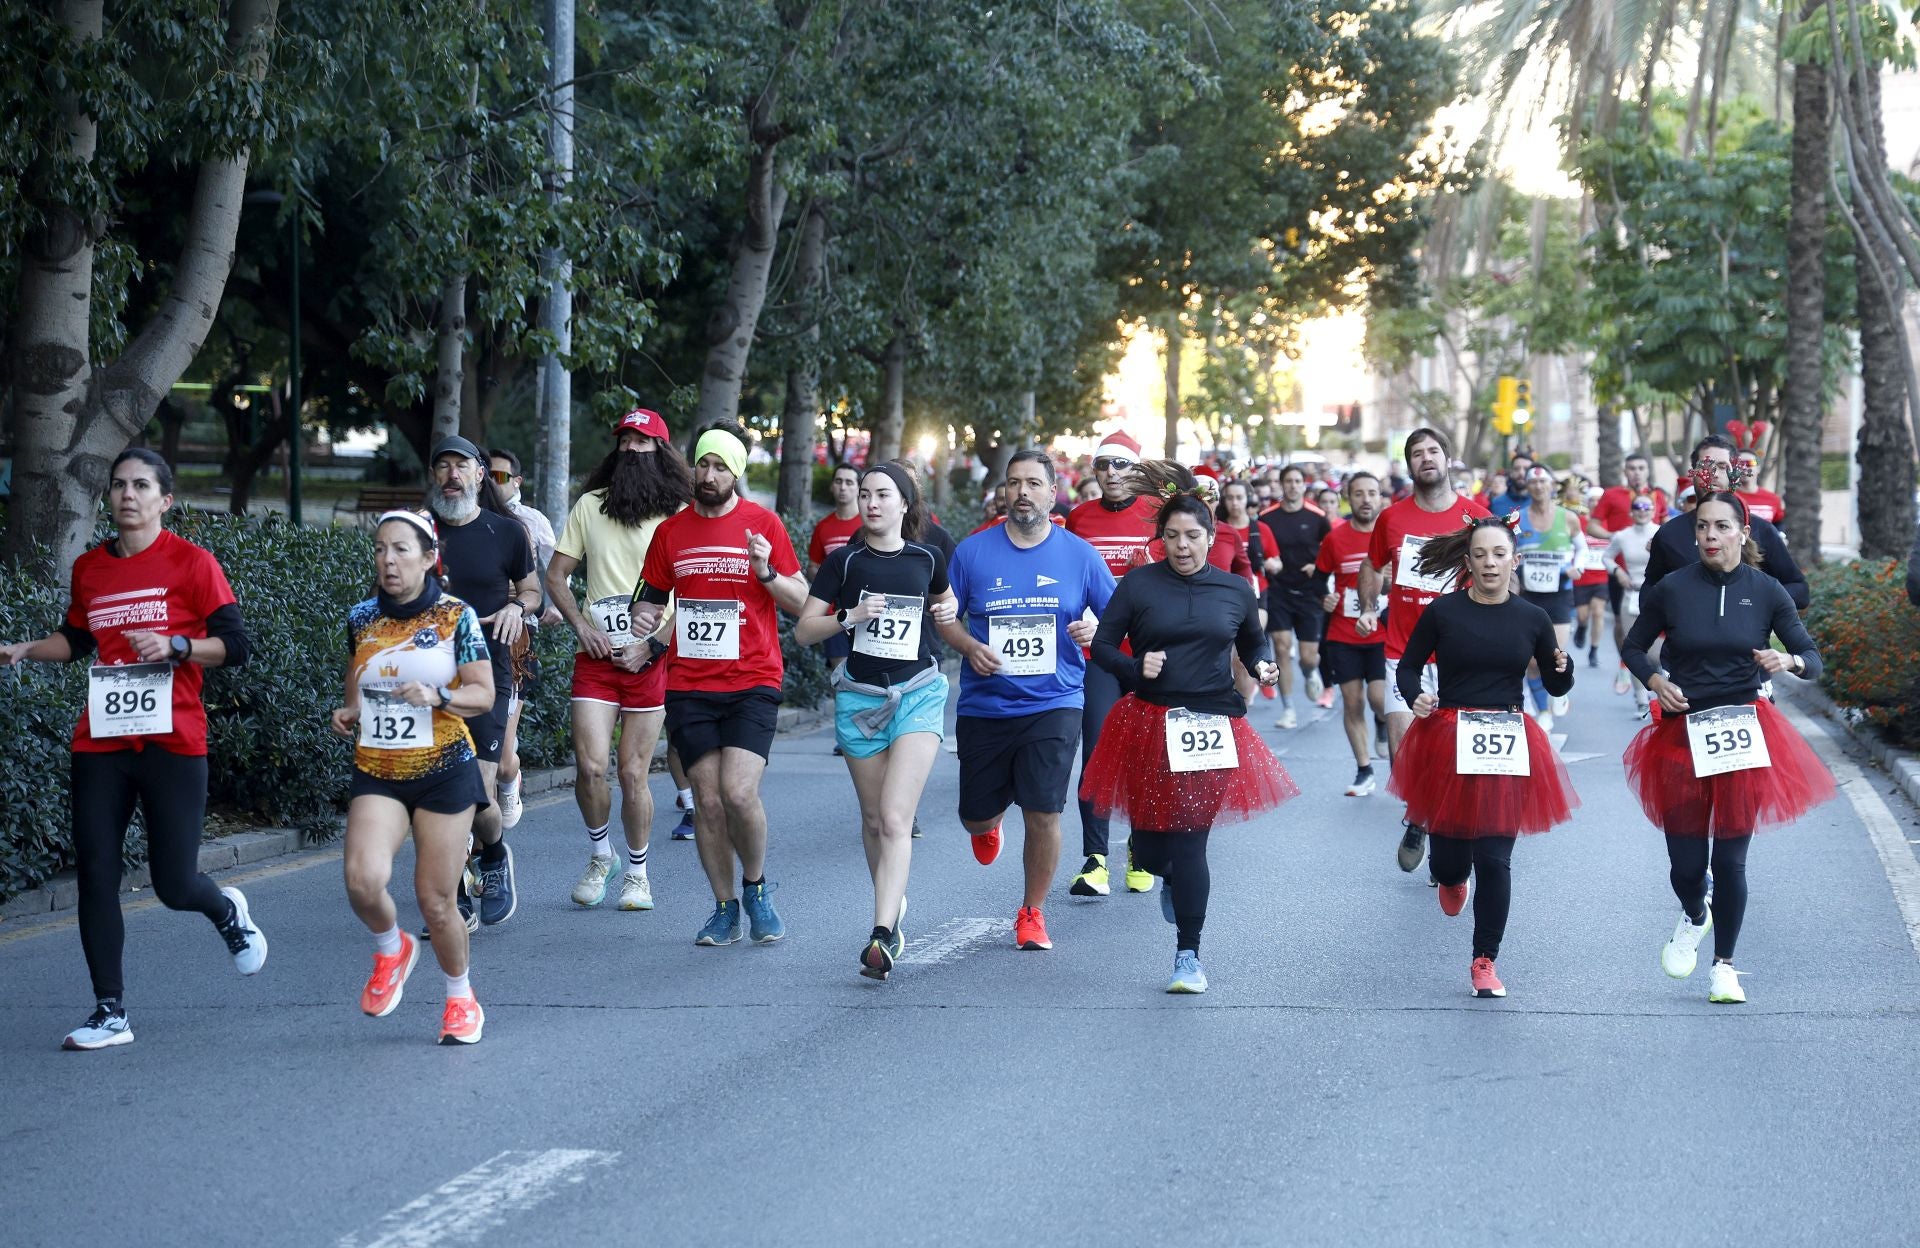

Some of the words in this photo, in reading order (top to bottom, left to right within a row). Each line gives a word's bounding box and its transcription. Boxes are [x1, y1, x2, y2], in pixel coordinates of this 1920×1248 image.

[717, 557, 749, 566] CARRERA
[715, 567, 749, 576] PALMILLA
[1530, 572, 1553, 583] 426
[154, 587, 168, 596] XIV
[129, 600, 168, 611] CARRERA
[986, 597, 1023, 608] CARRERA
[1025, 596, 1059, 604] URBANA
[99, 617, 125, 628] PALMA
[126, 613, 168, 624] PALMILLA
[117, 610, 129, 618] SAN
[130, 607, 167, 616] SILVESTRE
[603, 613, 631, 632] 16
[687, 621, 727, 641] 827
[866, 618, 912, 641] 437
[1002, 637, 1045, 657] 493
[105, 689, 156, 715] 896
[372, 716, 416, 740] 132
[1181, 729, 1224, 752] 932
[1472, 733, 1516, 755] 857
[1705, 728, 1752, 754] 539
